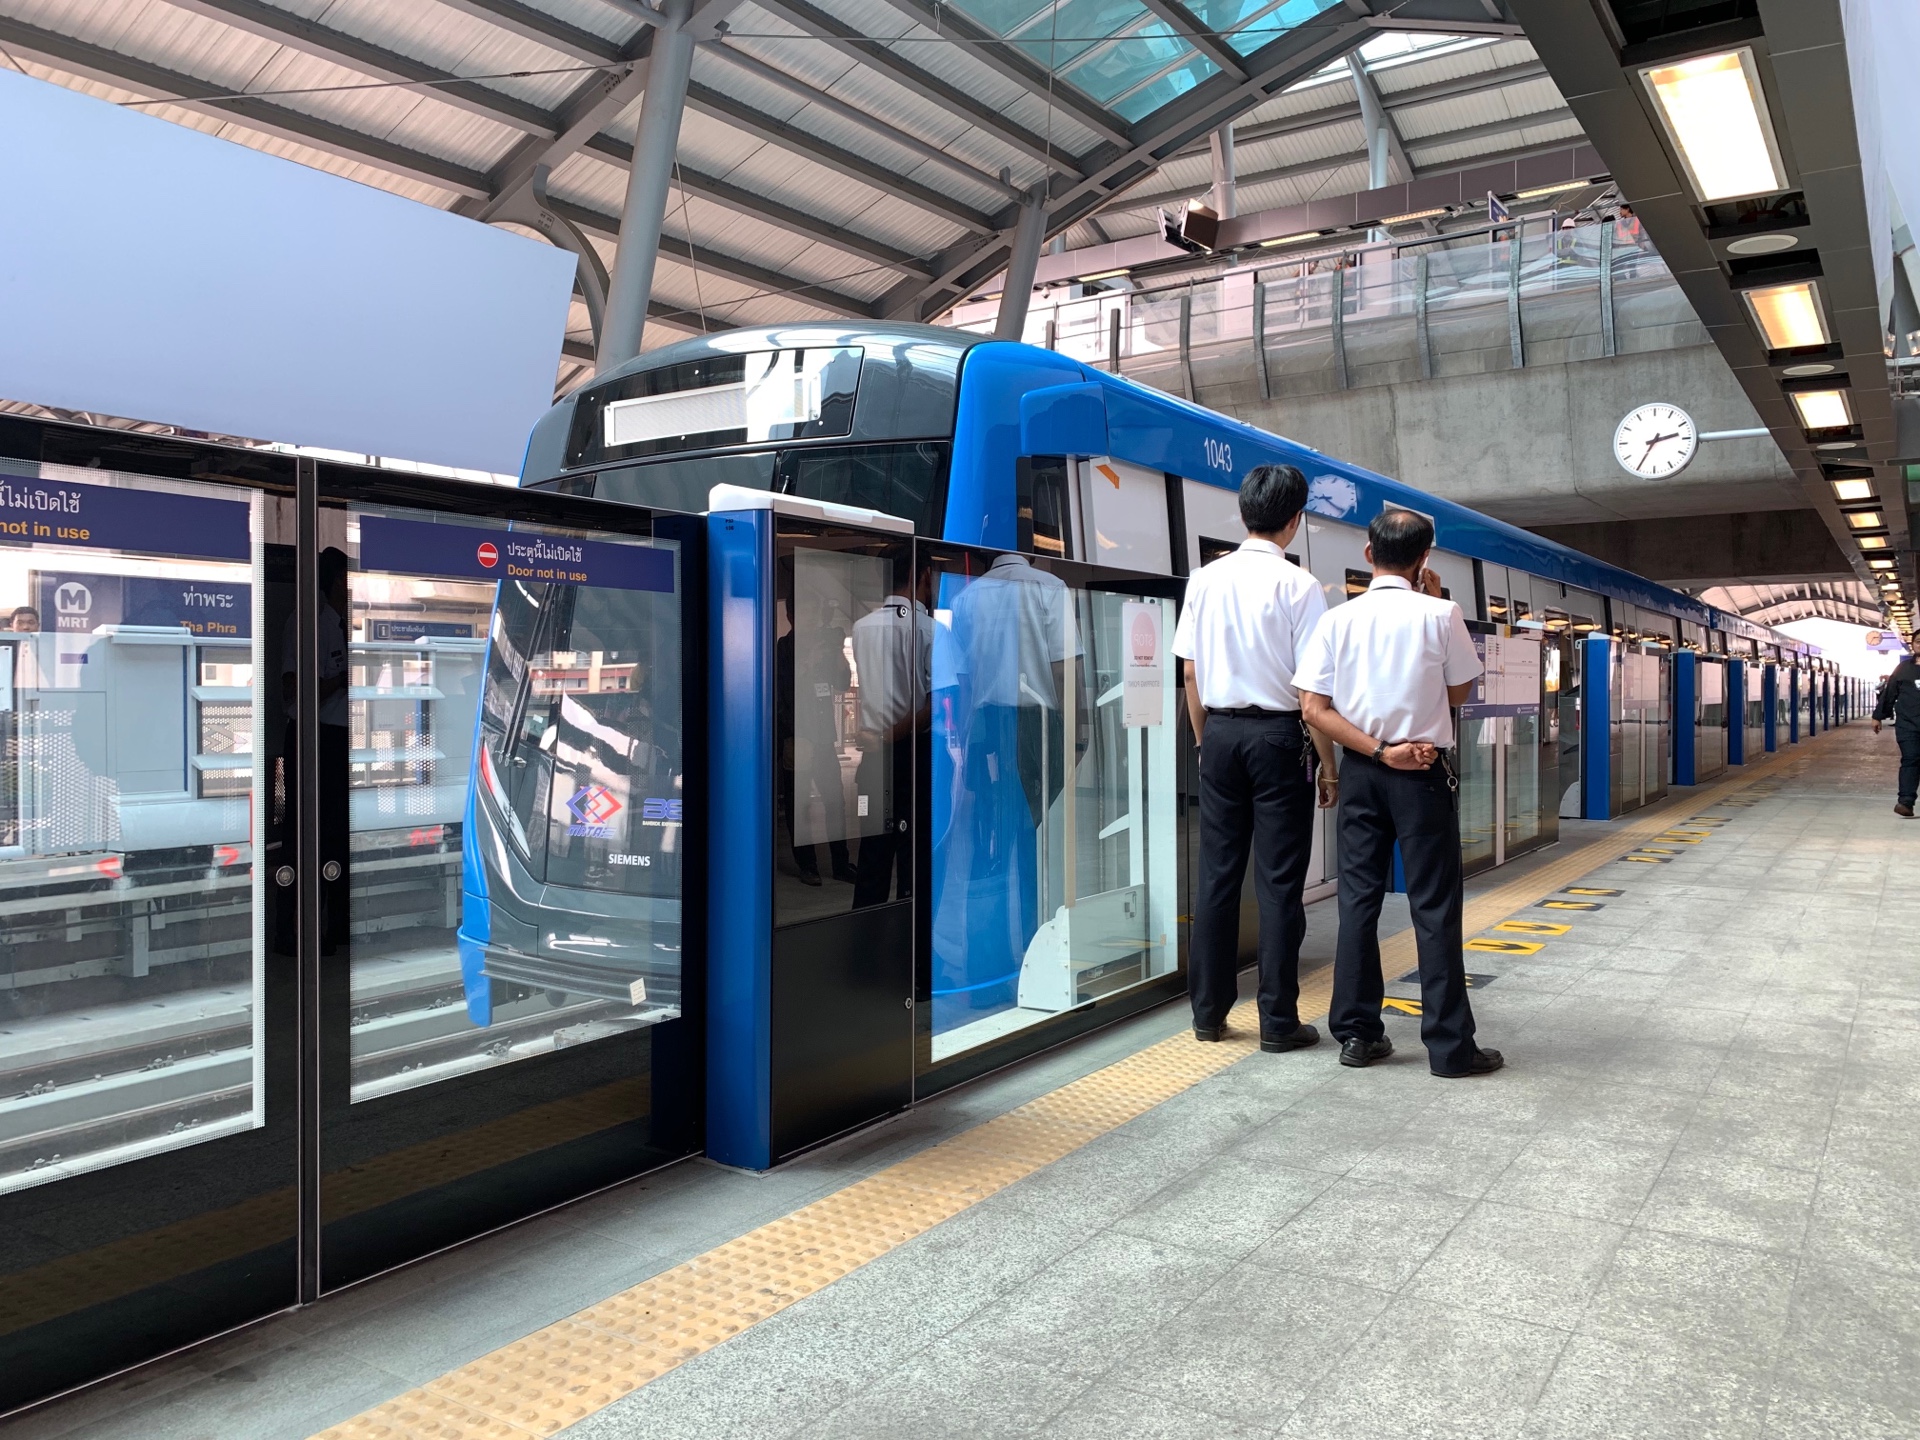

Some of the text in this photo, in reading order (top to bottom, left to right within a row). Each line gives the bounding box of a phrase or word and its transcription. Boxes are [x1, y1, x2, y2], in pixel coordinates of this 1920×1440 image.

[1204, 437, 1232, 472] 1043
[33, 521, 51, 537] in
[57, 527, 91, 540] use
[507, 539, 582, 564] ประตูนี้ไม่เปิดใช้
[507, 564, 588, 582] Door not in use
[182, 586, 234, 608] ท่าพระ
[57, 616, 89, 629] MRT
[180, 620, 237, 634] Tha Phra
[608, 853, 651, 867] SIEMENS
